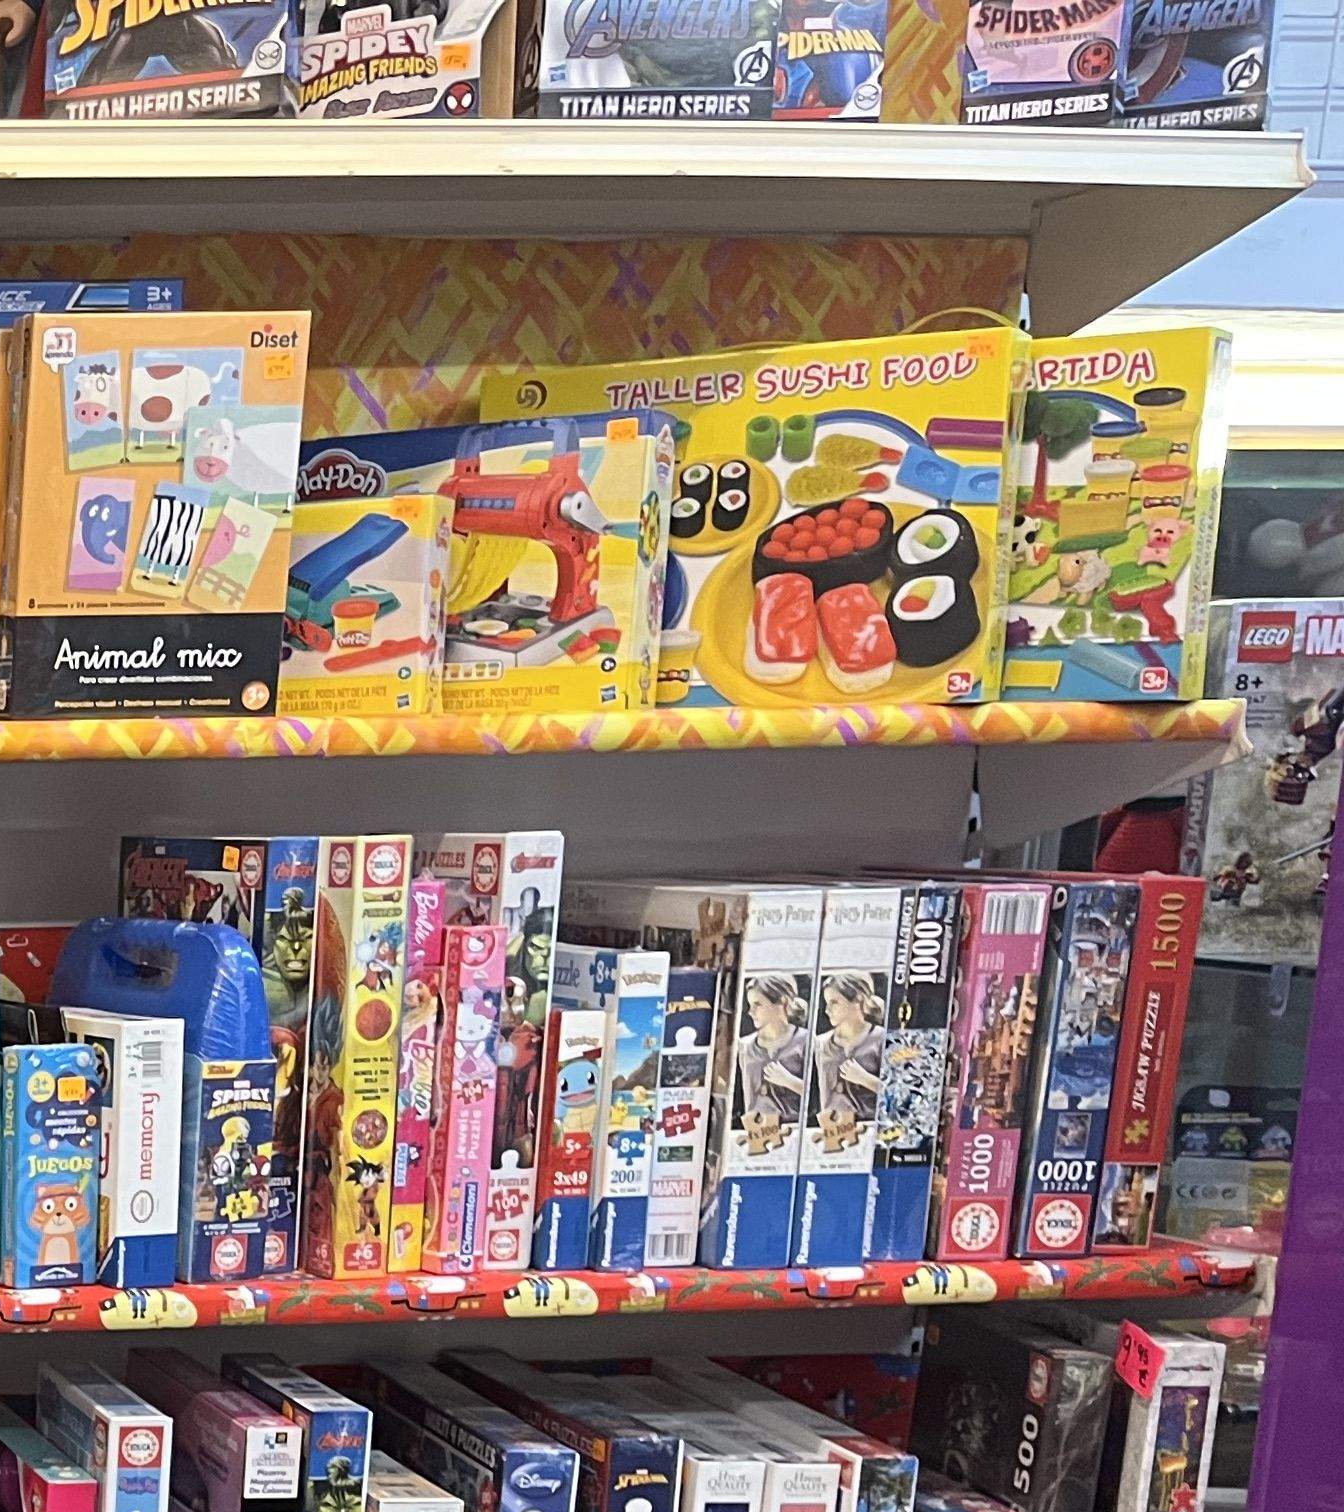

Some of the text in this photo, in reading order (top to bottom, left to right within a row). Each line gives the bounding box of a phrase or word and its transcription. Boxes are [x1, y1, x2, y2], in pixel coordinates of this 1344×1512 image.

[301, 24, 429, 72] SPIDEY
[370, 55, 438, 84] FRIENDS
[67, 83, 262, 119] TITAN HERO SERIES
[559, 95, 751, 118] TITAN HERO SERIES
[965, 93, 1109, 124] TITAN HERO SERIES
[1202, 104, 1259, 126] SERIES
[250, 324, 299, 349] Diset
[606, 347, 980, 409] TALLER SUSHI FOOD
[1243, 627, 1291, 647] LEGO
[53, 637, 243, 671] Animal mix
[1142, 671, 1166, 690] 3+
[1234, 673, 1264, 692] 8+
[1151, 892, 1187, 973] 1500
[909, 919, 942, 985] 1000
[1141, 991, 1162, 1048] PUZZLE
[139, 1092, 160, 1181] memory
[610, 1169, 636, 1184] 200
[970, 1134, 996, 1194] 1000
[1037, 1160, 1098, 1183] 1000
[494, 1195, 520, 1212] 100
[1013, 1412, 1039, 1494] 500
